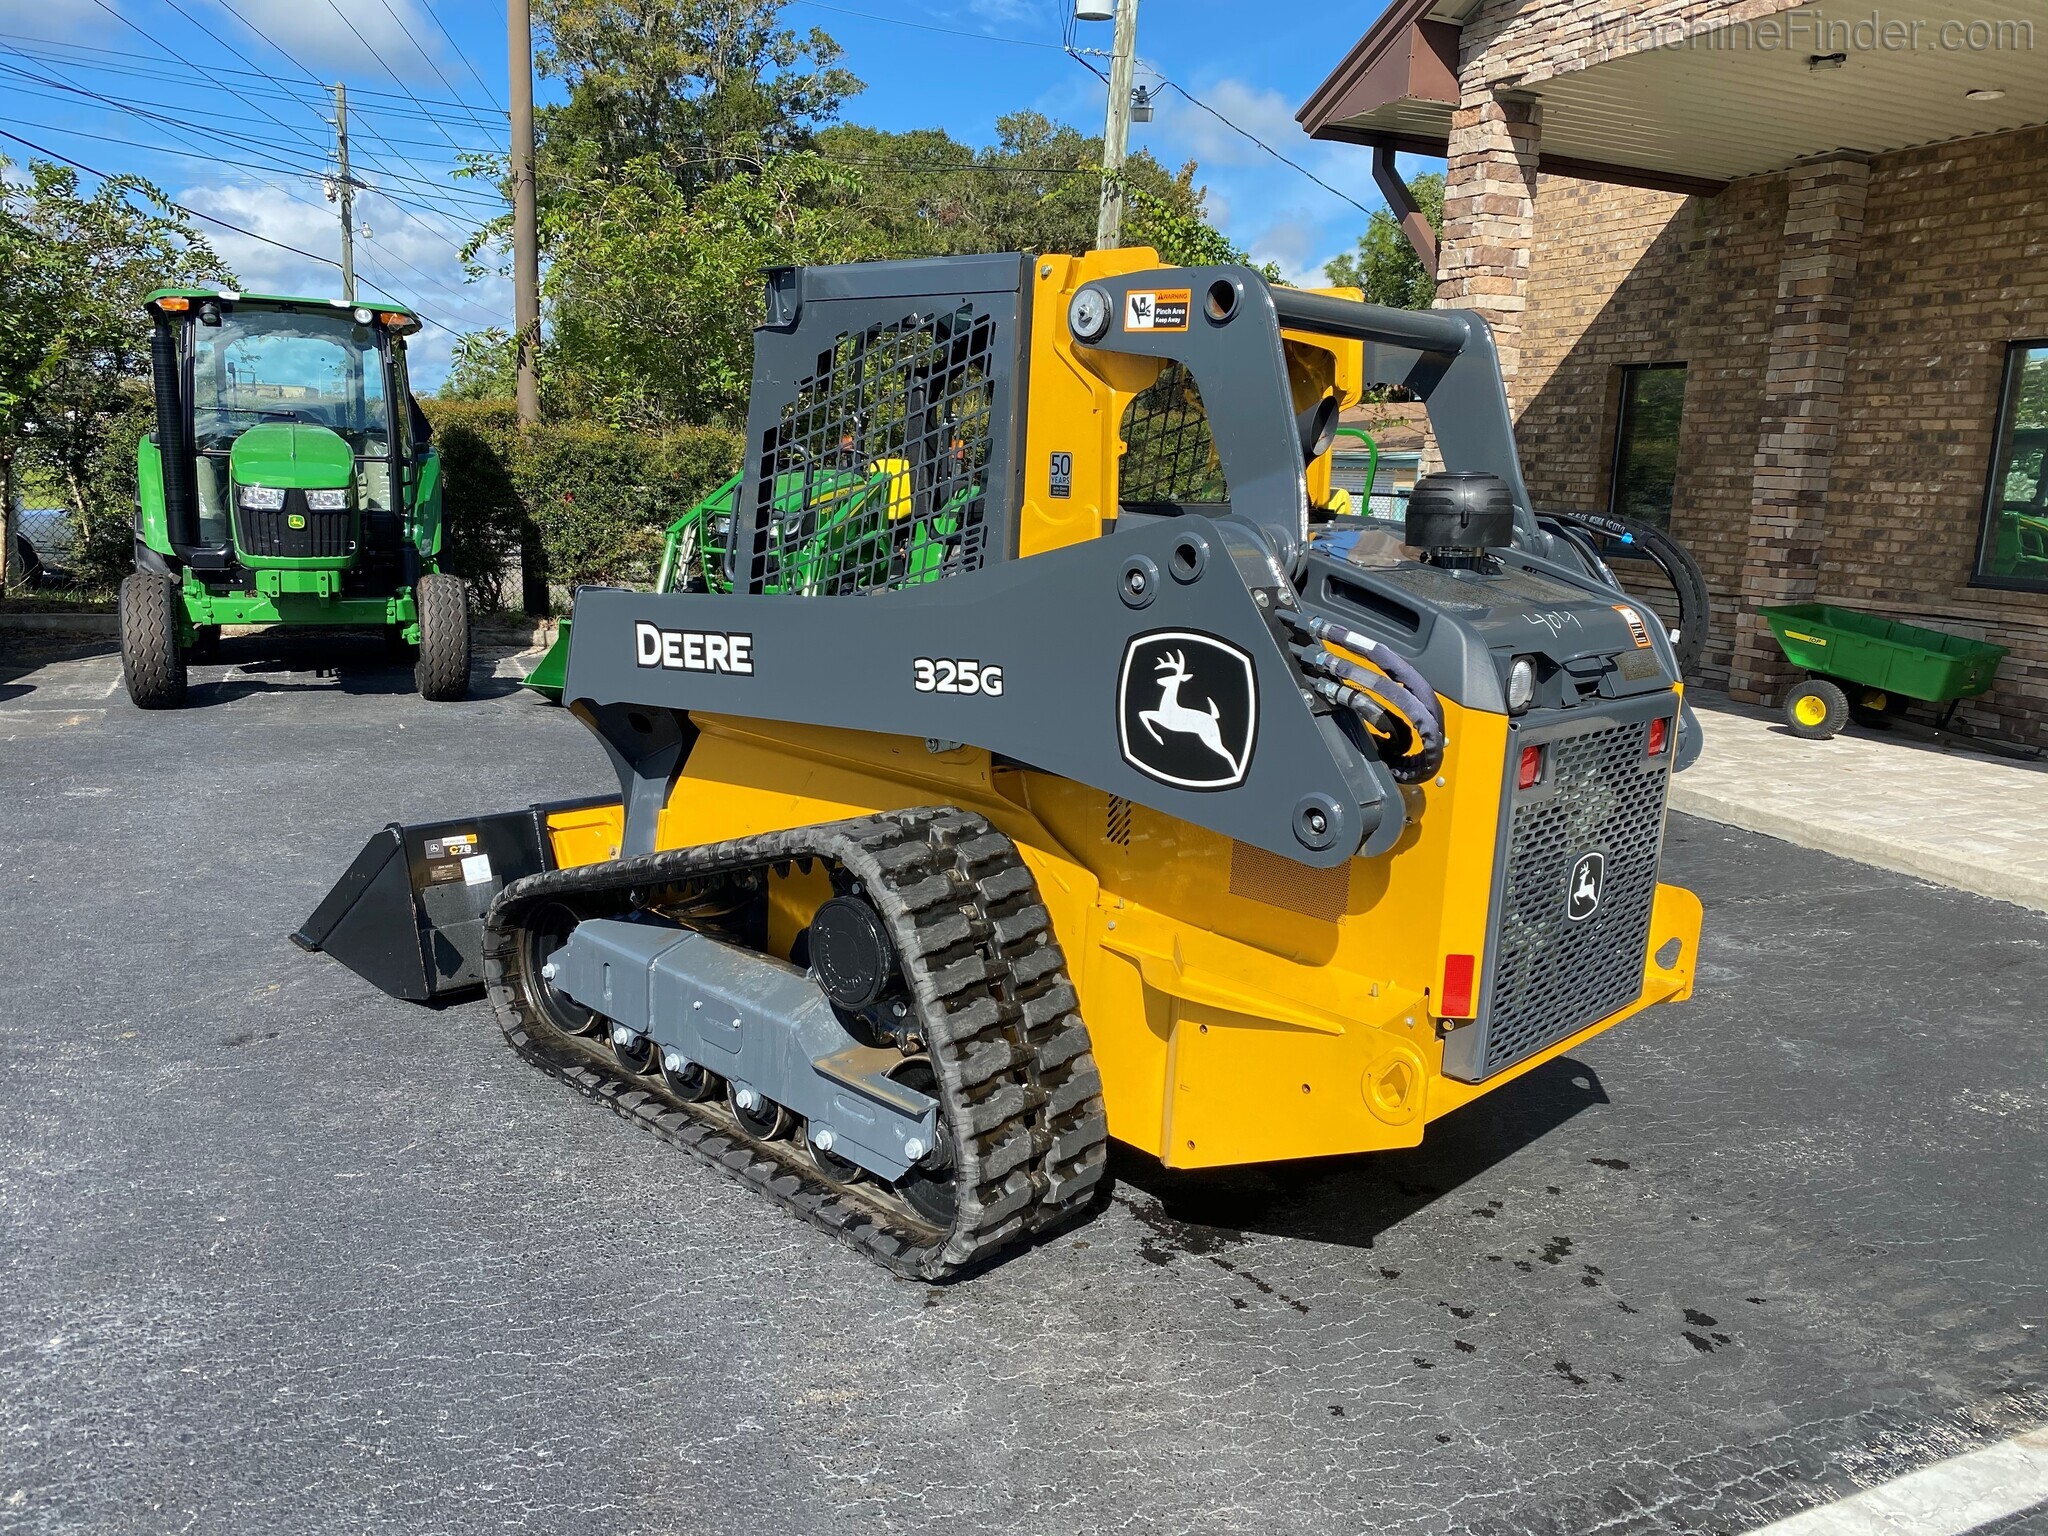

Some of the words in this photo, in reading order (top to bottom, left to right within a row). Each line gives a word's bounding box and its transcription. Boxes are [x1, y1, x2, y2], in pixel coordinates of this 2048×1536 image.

[1051, 454, 1071, 476] 50
[635, 621, 753, 675] DEERE
[914, 658, 1003, 696] 325G
[449, 844, 472, 854] C78
